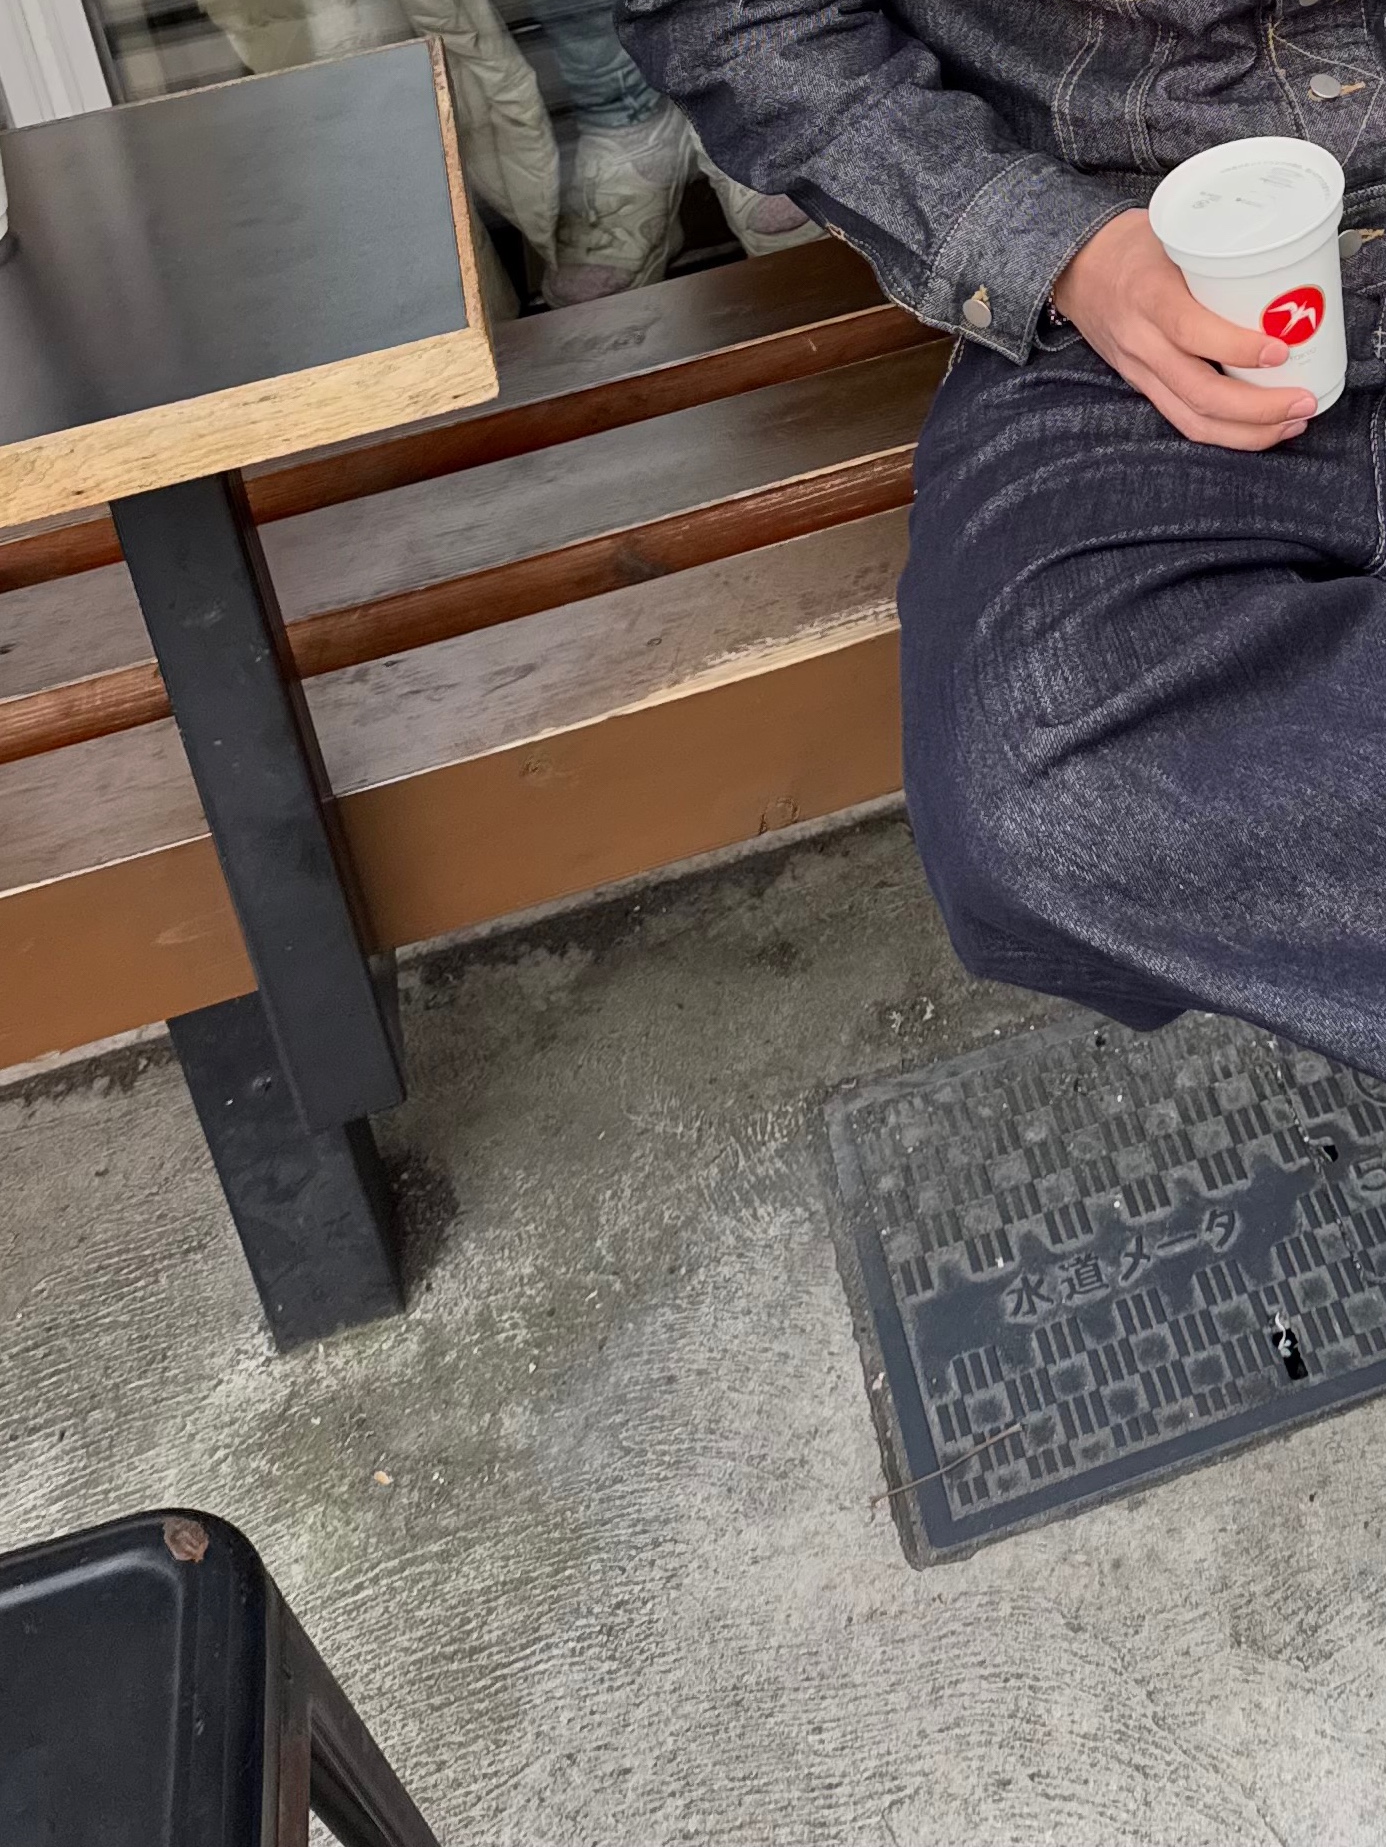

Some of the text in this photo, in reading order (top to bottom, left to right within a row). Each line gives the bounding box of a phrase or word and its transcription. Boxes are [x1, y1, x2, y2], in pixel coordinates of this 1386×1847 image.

[1004, 1208, 1238, 1318] 水道メータ
